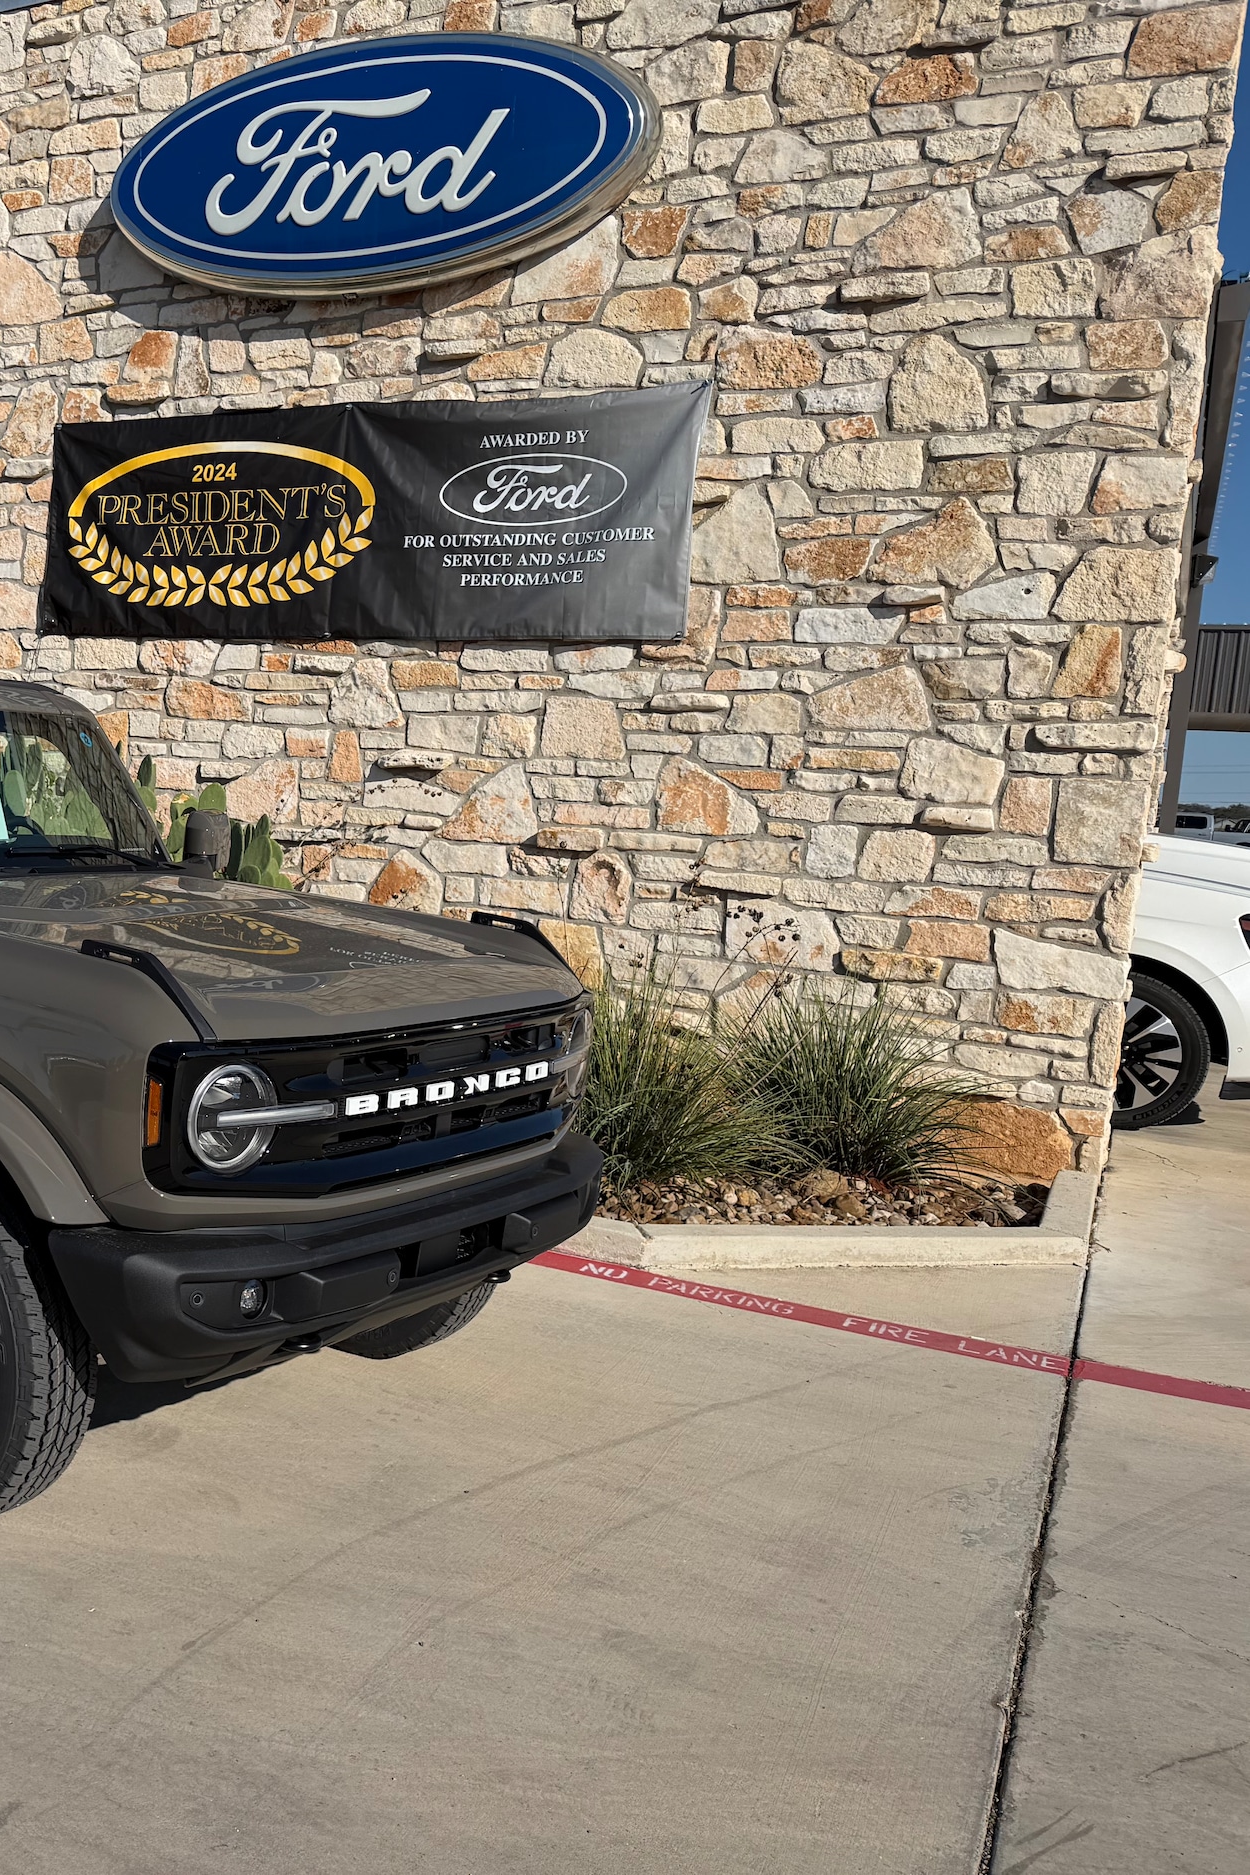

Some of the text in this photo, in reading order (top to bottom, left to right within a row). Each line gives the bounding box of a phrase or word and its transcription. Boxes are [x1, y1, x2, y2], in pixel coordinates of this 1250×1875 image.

[205, 88, 510, 236] Ford
[479, 429, 589, 449] AWARDED BY
[191, 462, 238, 483] 2024
[473, 463, 593, 514] Ford
[96, 482, 347, 526] PRESIDENT'S
[142, 522, 281, 558] AWARD
[403, 527, 655, 549] FOR OUTSTANDING CUSTOMER
[442, 549, 606, 568] SERVICE AND SALES
[459, 569, 584, 588] PERFORMANCE
[345, 1061, 549, 1116] BRONCO
[579, 1263, 1068, 1373] NO PARKING FIRE LANE
